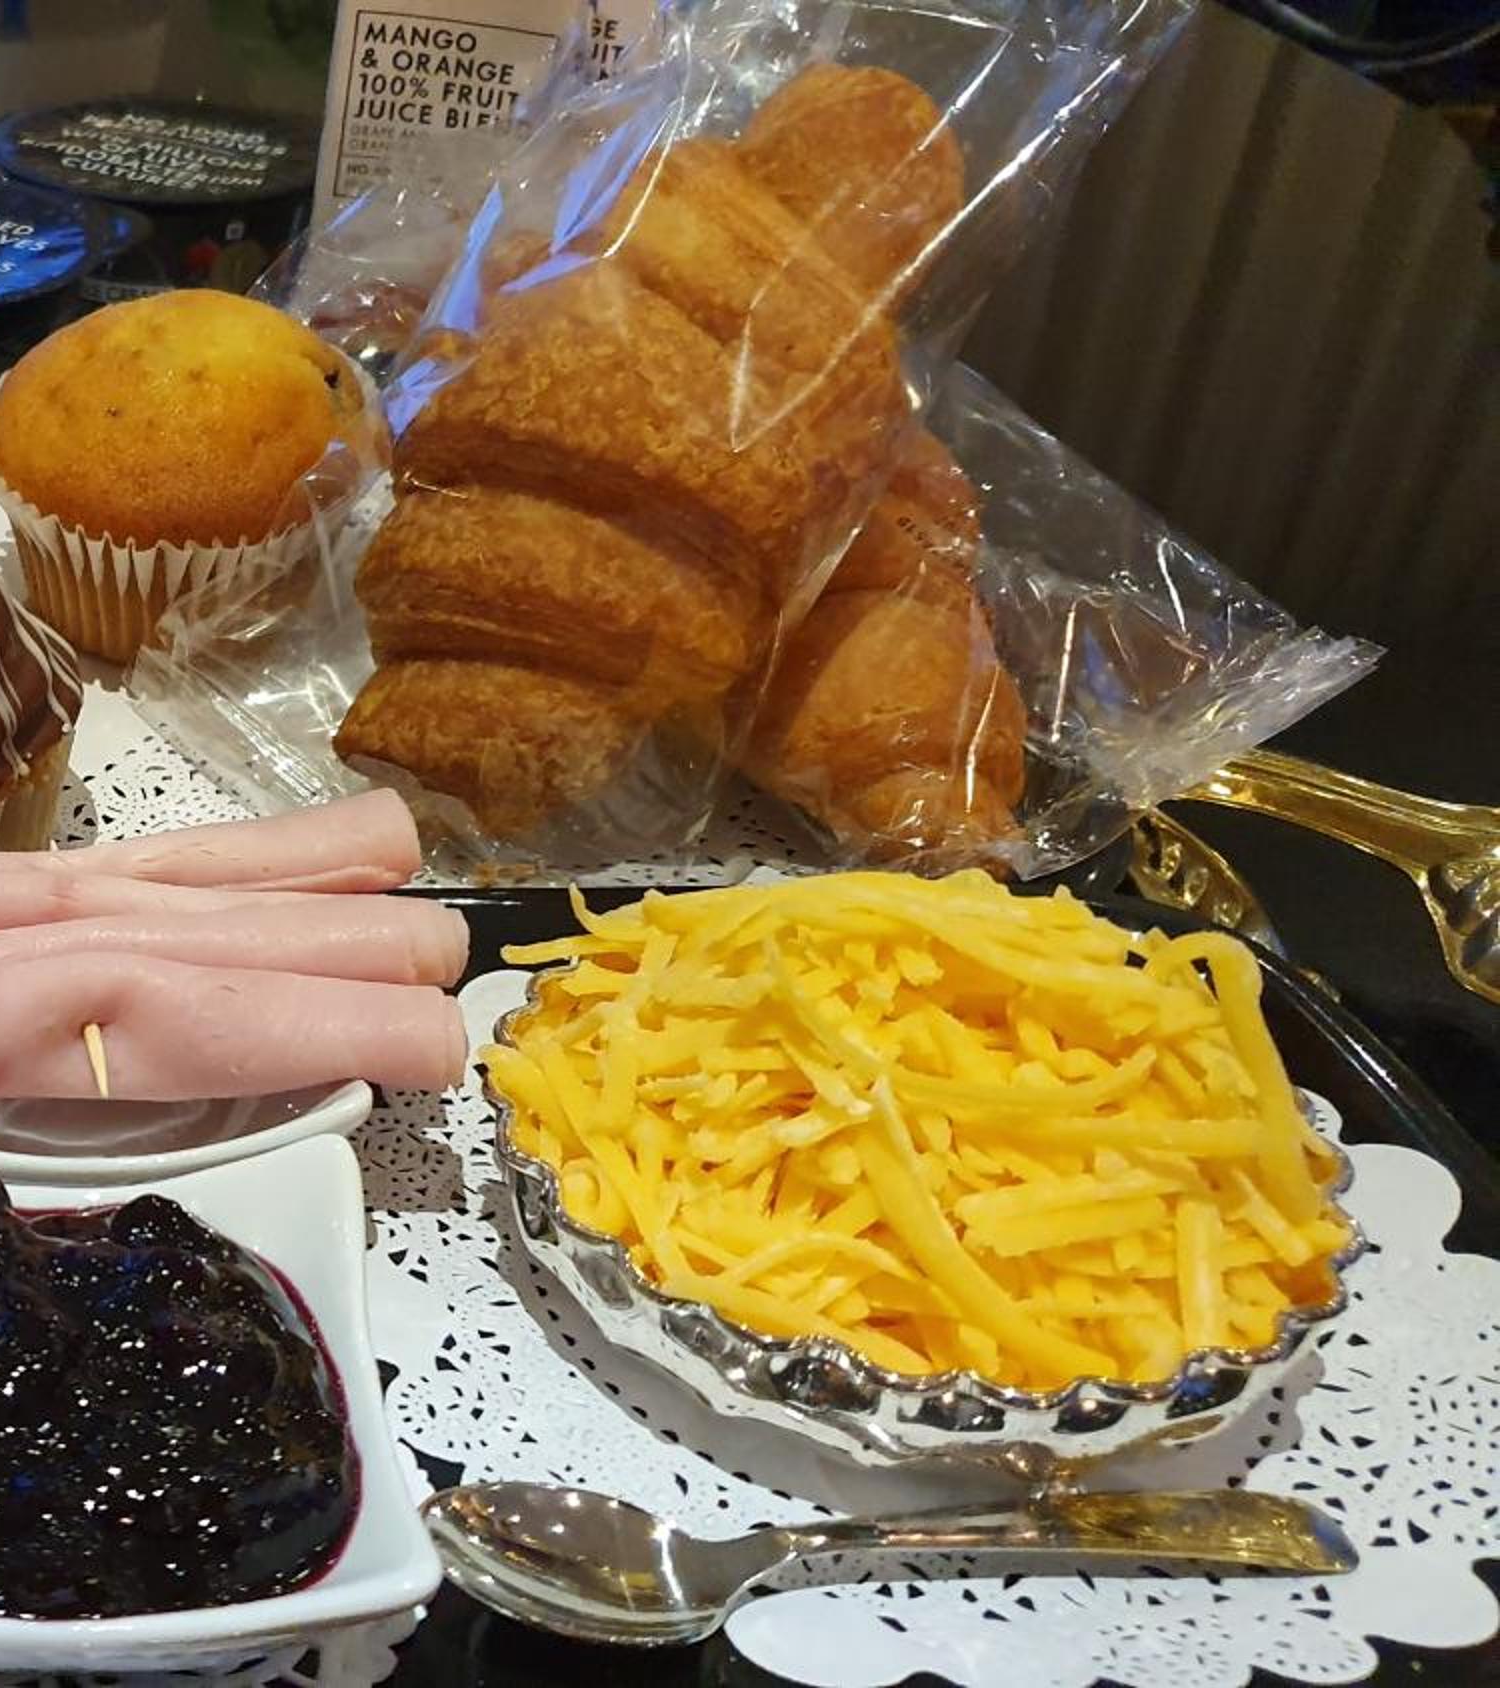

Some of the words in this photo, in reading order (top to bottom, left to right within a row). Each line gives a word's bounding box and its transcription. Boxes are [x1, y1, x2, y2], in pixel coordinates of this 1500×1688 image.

[364, 22, 477, 53] MANGO
[360, 49, 379, 69] &
[392, 49, 515, 86] ORANGE
[358, 73, 429, 99] 100%
[354, 99, 432, 126] JUICE
[138, 141, 269, 172] MILLIONS
[61, 156, 199, 190] CULTURES
